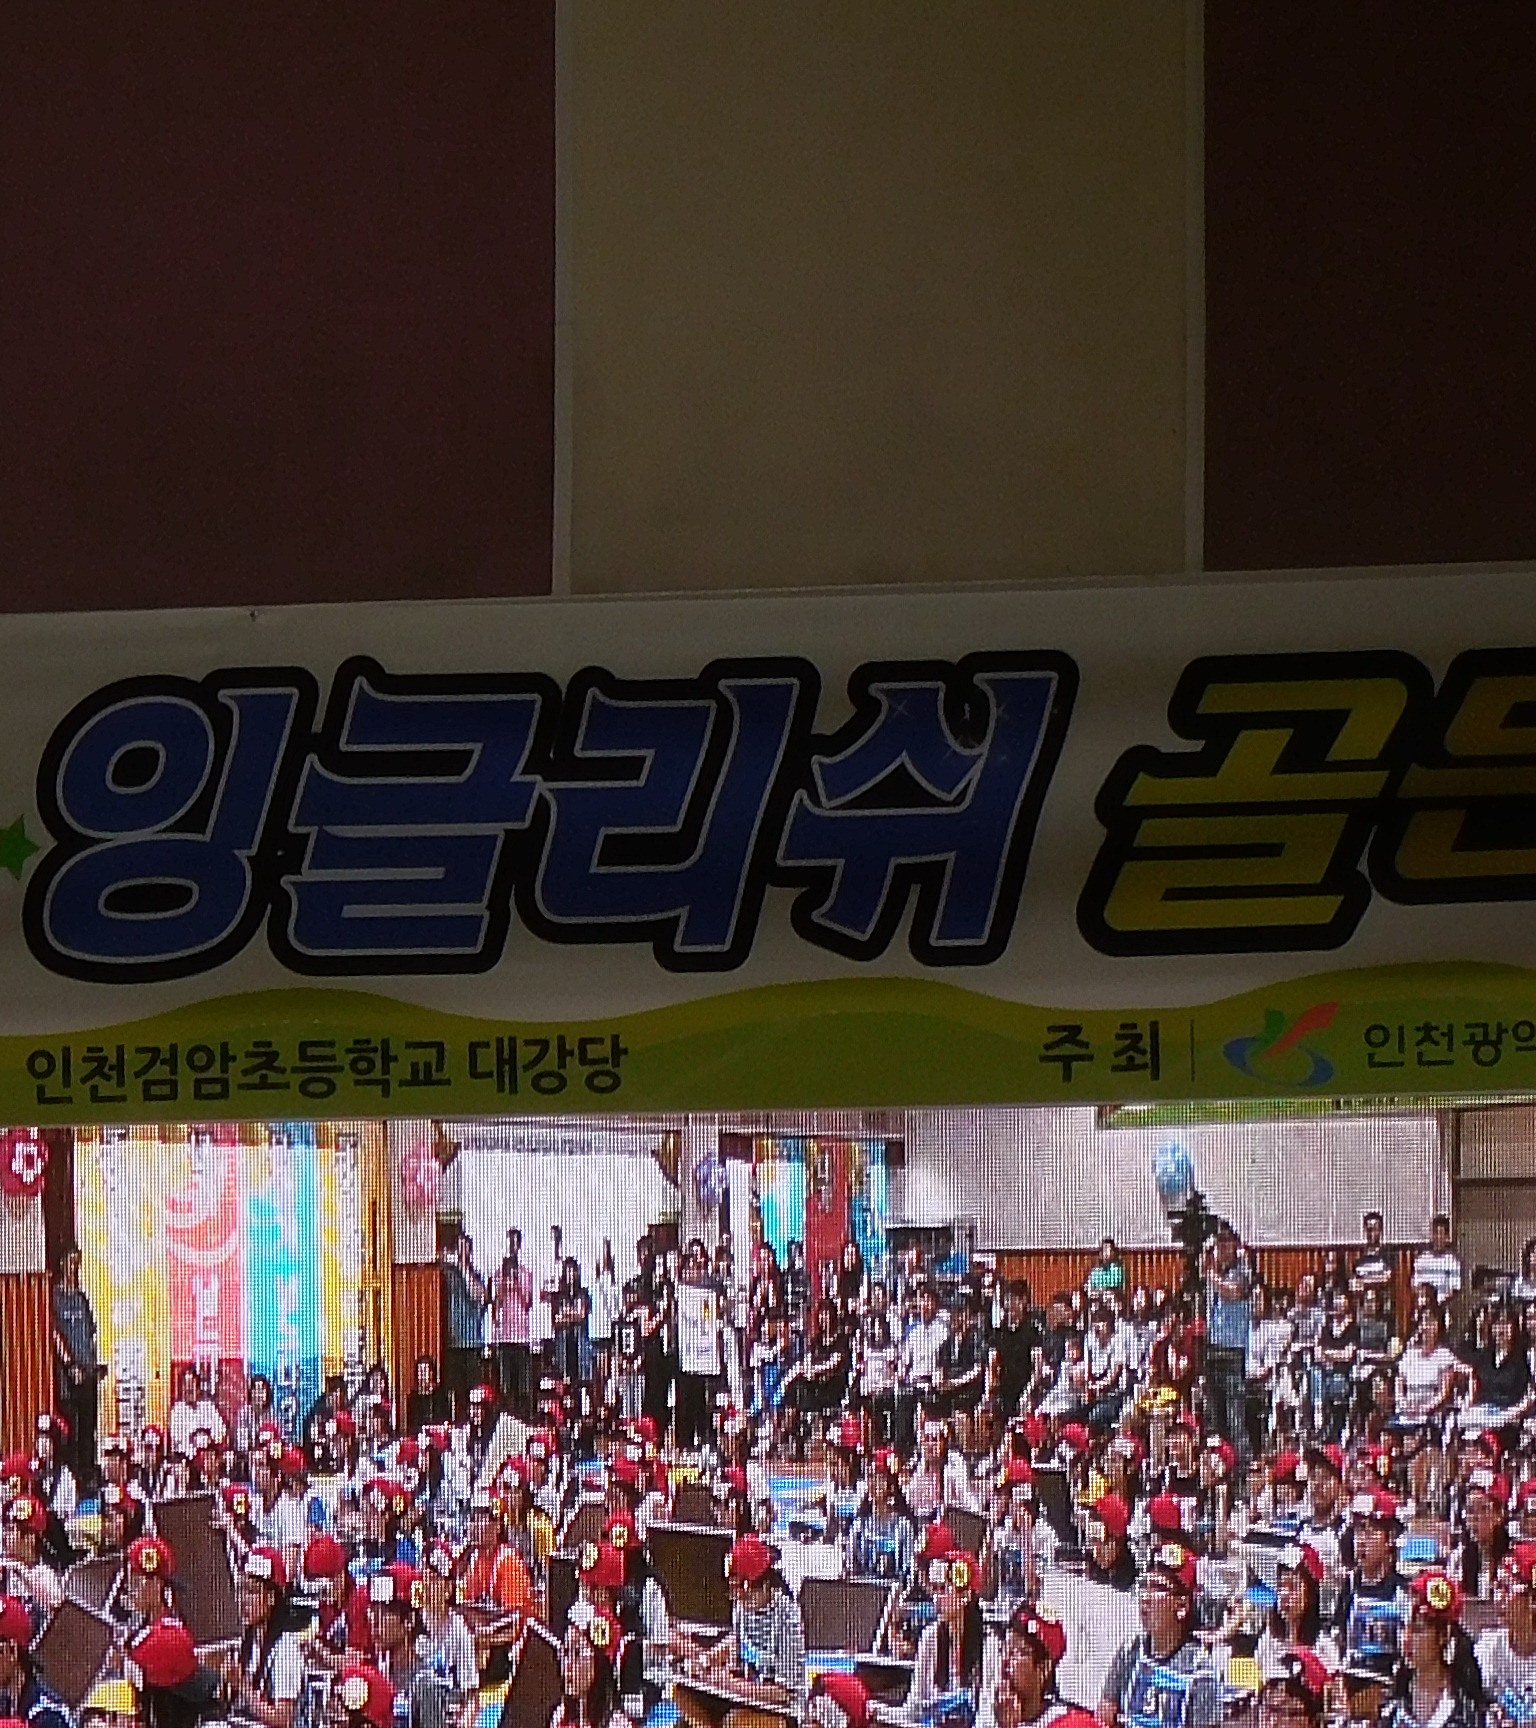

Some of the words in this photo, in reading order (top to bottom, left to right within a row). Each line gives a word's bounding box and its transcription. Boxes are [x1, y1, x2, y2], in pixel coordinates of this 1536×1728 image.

[29, 652, 1076, 983] 잉글리쉬
[26, 1038, 454, 1102] 인천검암초등학교
[467, 1033, 630, 1097] 대강당
